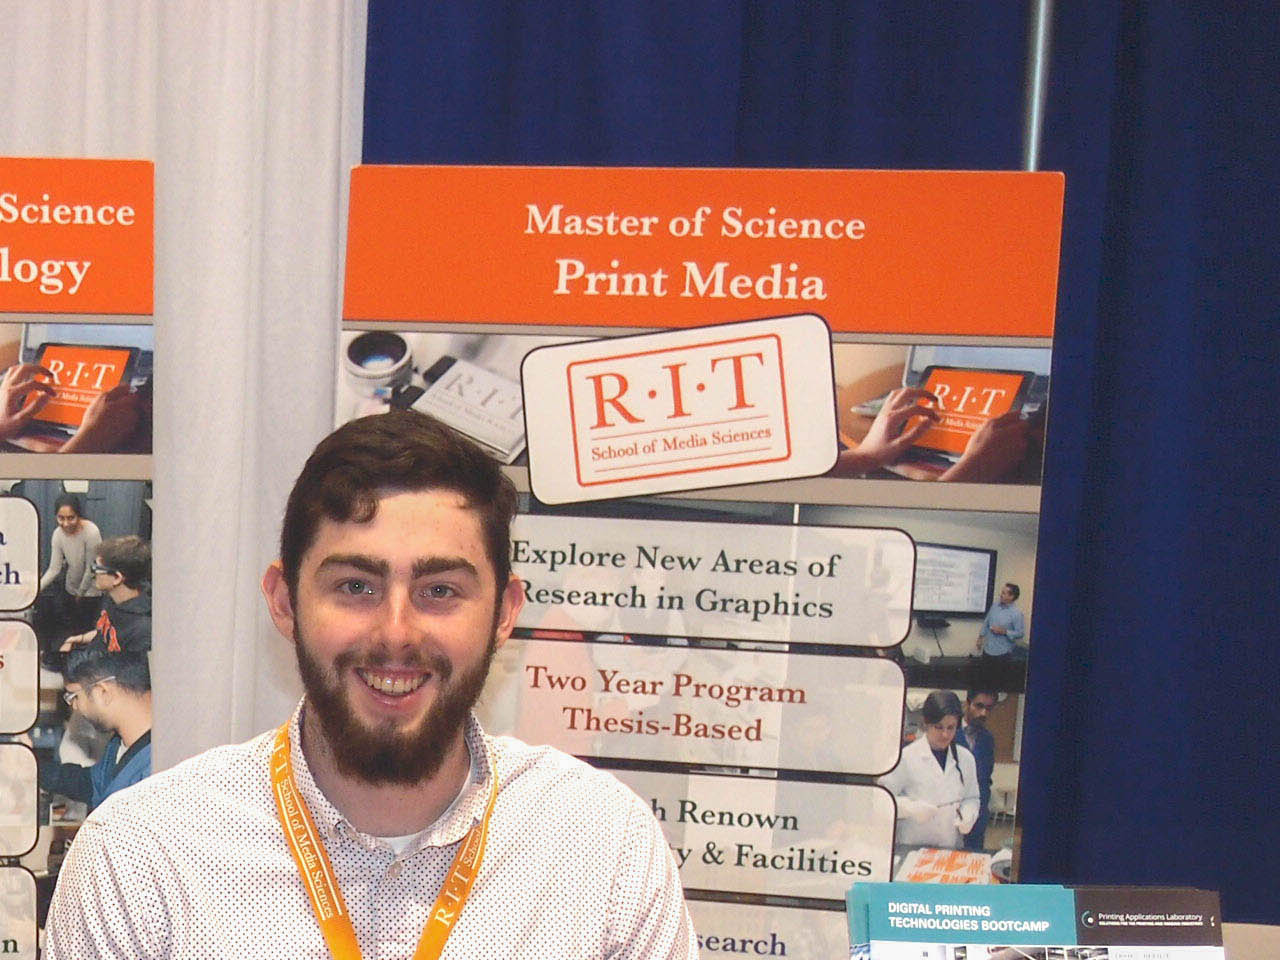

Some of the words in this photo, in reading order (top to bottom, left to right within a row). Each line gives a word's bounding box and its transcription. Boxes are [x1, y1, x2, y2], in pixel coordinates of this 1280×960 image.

[524, 204, 659, 237] Master
[668, 206, 712, 238] of
[720, 206, 867, 241] Science
[553, 258, 669, 297] Print
[682, 261, 828, 302] Media
[591, 442, 639, 463] School
[642, 439, 659, 455] of
[662, 434, 708, 452] Media
[711, 427, 772, 447] Sciences
[511, 540, 627, 572] Explore
[635, 546, 701, 575] New
[709, 549, 799, 577] Areas
[807, 554, 843, 579] of
[657, 586, 685, 611] in
[694, 588, 835, 624] Graphics
[524, 665, 588, 693] Two
[596, 669, 664, 697] Year
[672, 673, 808, 709] Program
[562, 706, 764, 743] Thesis-Based
[280, 779, 299, 819] School
[677, 799, 800, 831] Renown
[291, 816, 305, 831] of
[297, 831, 316, 869] Media
[701, 841, 726, 866] &
[733, 843, 874, 878] Facilities
[312, 869, 335, 919] Sciences
[888, 902, 933, 915] DIGITAL
[935, 904, 991, 918] PRINTING
[888, 916, 979, 931] TECHNOLOGIES
[982, 918, 1051, 933] BOOTCAMP
[1098, 912, 1124, 921] Printing
[1125, 913, 1165, 921] Applications
[1166, 913, 1203, 922] Laboratory
